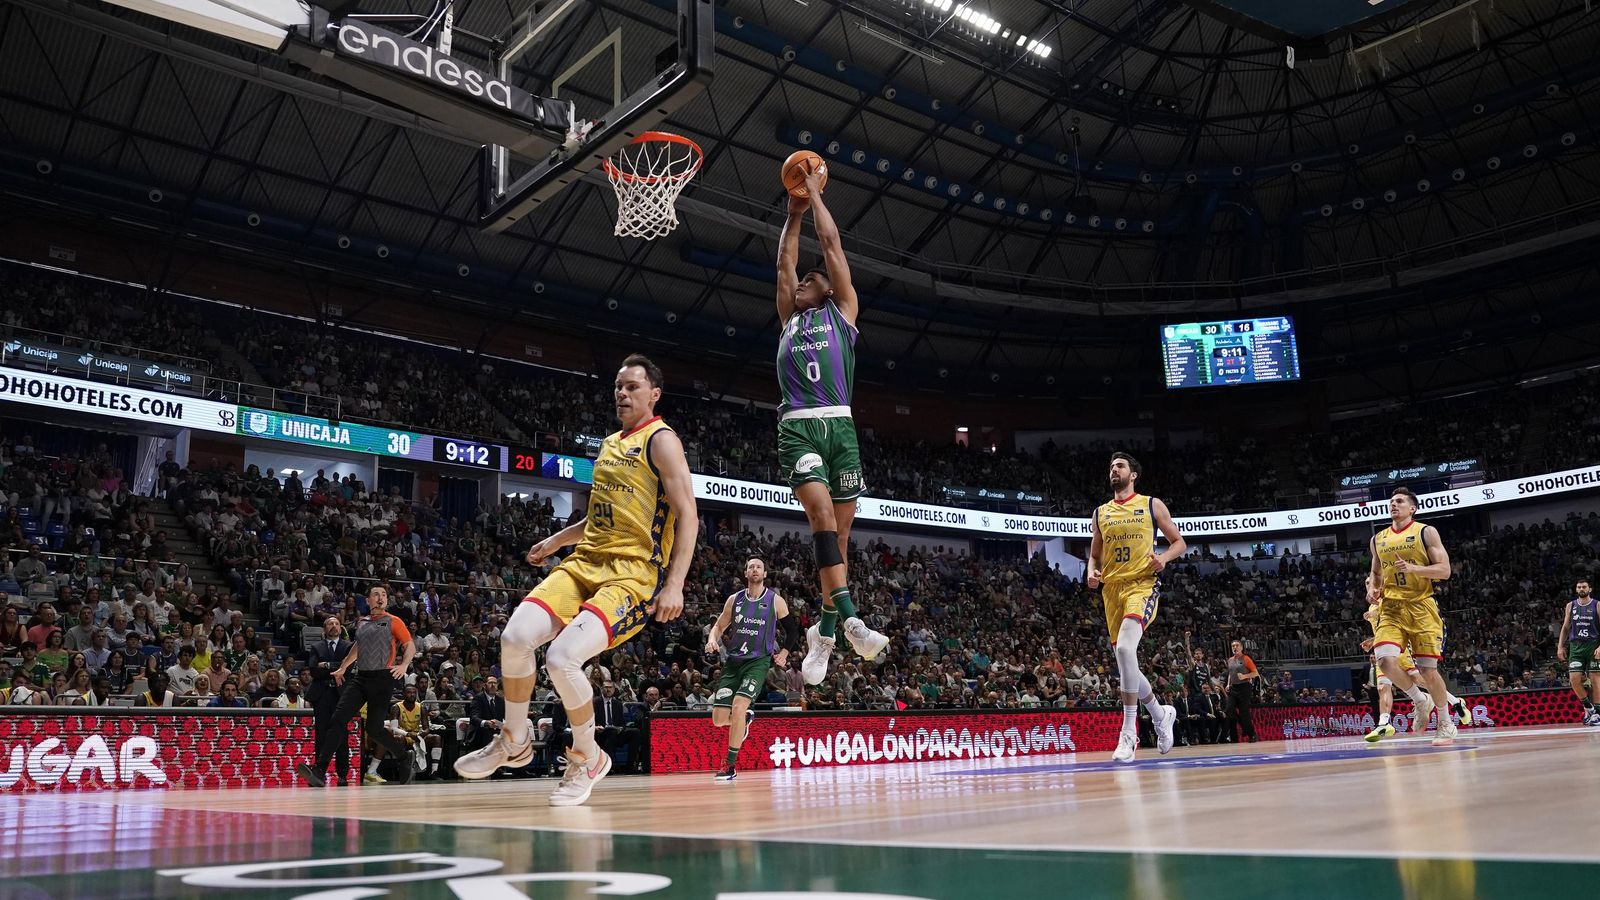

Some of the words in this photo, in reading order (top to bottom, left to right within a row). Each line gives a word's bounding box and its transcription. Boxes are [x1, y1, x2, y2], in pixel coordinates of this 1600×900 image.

[338, 24, 511, 110] endesa
[801, 323, 833, 336] nicaja
[1205, 325, 1217, 334] 30
[1222, 324, 1233, 332] VS
[1238, 323, 1250, 332] 16
[23, 346, 58, 360] Unicaja
[791, 339, 829, 353] málaga
[1221, 347, 1242, 358] 9:11
[95, 359, 128, 372] Unicaja
[806, 361, 821, 383] 0
[160, 370, 191, 383] Unicaja
[281, 419, 351, 445] UNICAJA
[387, 432, 411, 455] 30
[445, 442, 489, 465] 9:12
[515, 454, 535, 471] 20
[557, 457, 574, 479] 16
[840, 478, 859, 488] laga
[706, 481, 737, 498] SOHO
[740, 485, 794, 505] BOUTIQUE
[1318, 508, 1350, 522] SOHO
[1354, 503, 1389, 518] BOUTI
[1417, 493, 1460, 510] HOTELS
[593, 503, 615, 528] 24
[879, 504, 966, 525] SOHOHOTELES.COM
[1004, 518, 1029, 531] SOHO
[1032, 520, 1079, 534] BOUTIQUE
[1108, 517, 1144, 526] MORABANC
[1112, 533, 1143, 541] Andorra
[1114, 546, 1131, 563] 33
[1383, 543, 1415, 553] MORABANC
[1394, 571, 1407, 586] 13
[743, 617, 766, 626] Unicaja
[1578, 628, 1589, 637] 45
[740, 641, 749, 654] 4
[769, 718, 1076, 768] #UNBALÓNPARANOJUGAR
